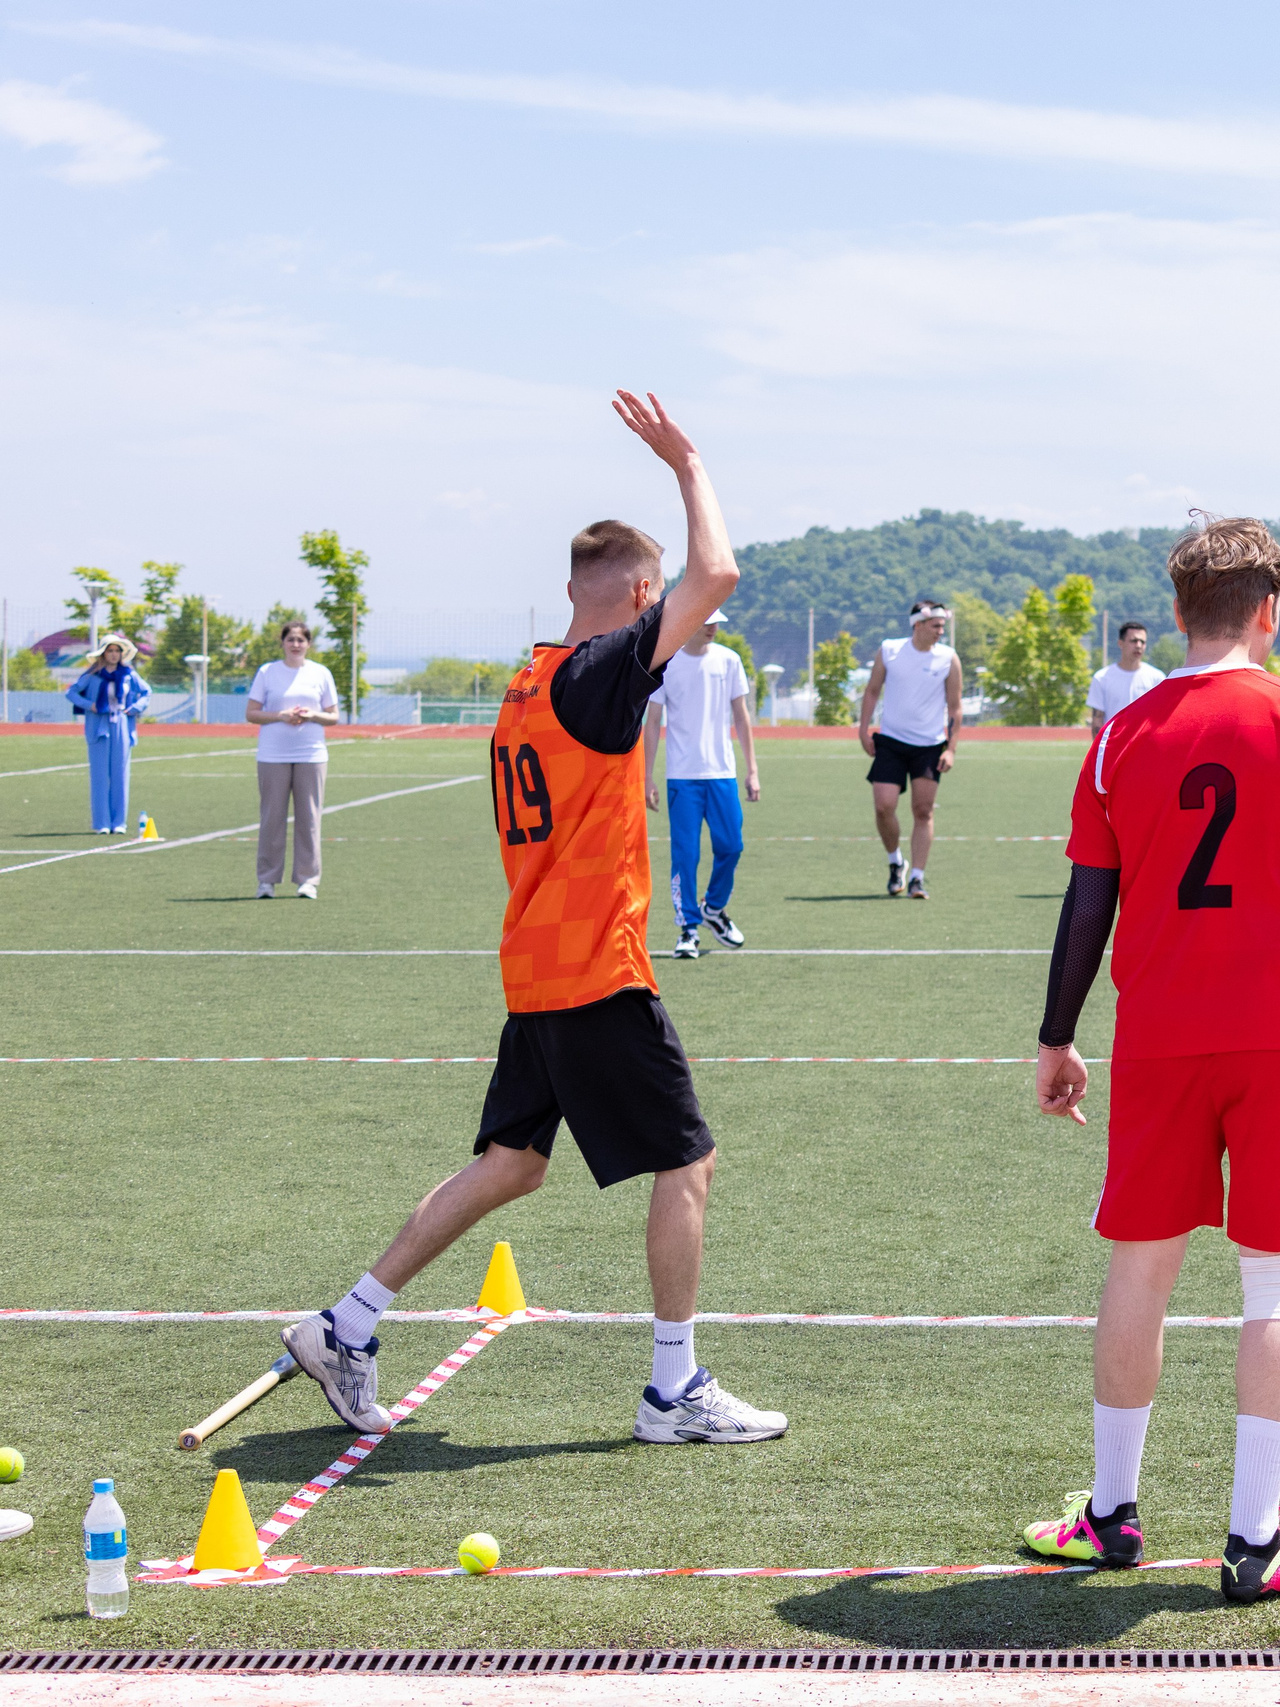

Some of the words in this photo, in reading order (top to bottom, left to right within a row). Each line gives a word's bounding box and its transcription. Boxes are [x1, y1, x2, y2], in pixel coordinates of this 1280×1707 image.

[497, 742, 554, 846] 19
[1178, 763, 1236, 910] 2
[350, 1291, 380, 1314] DEMIX
[654, 1337, 685, 1347] DEMIX
